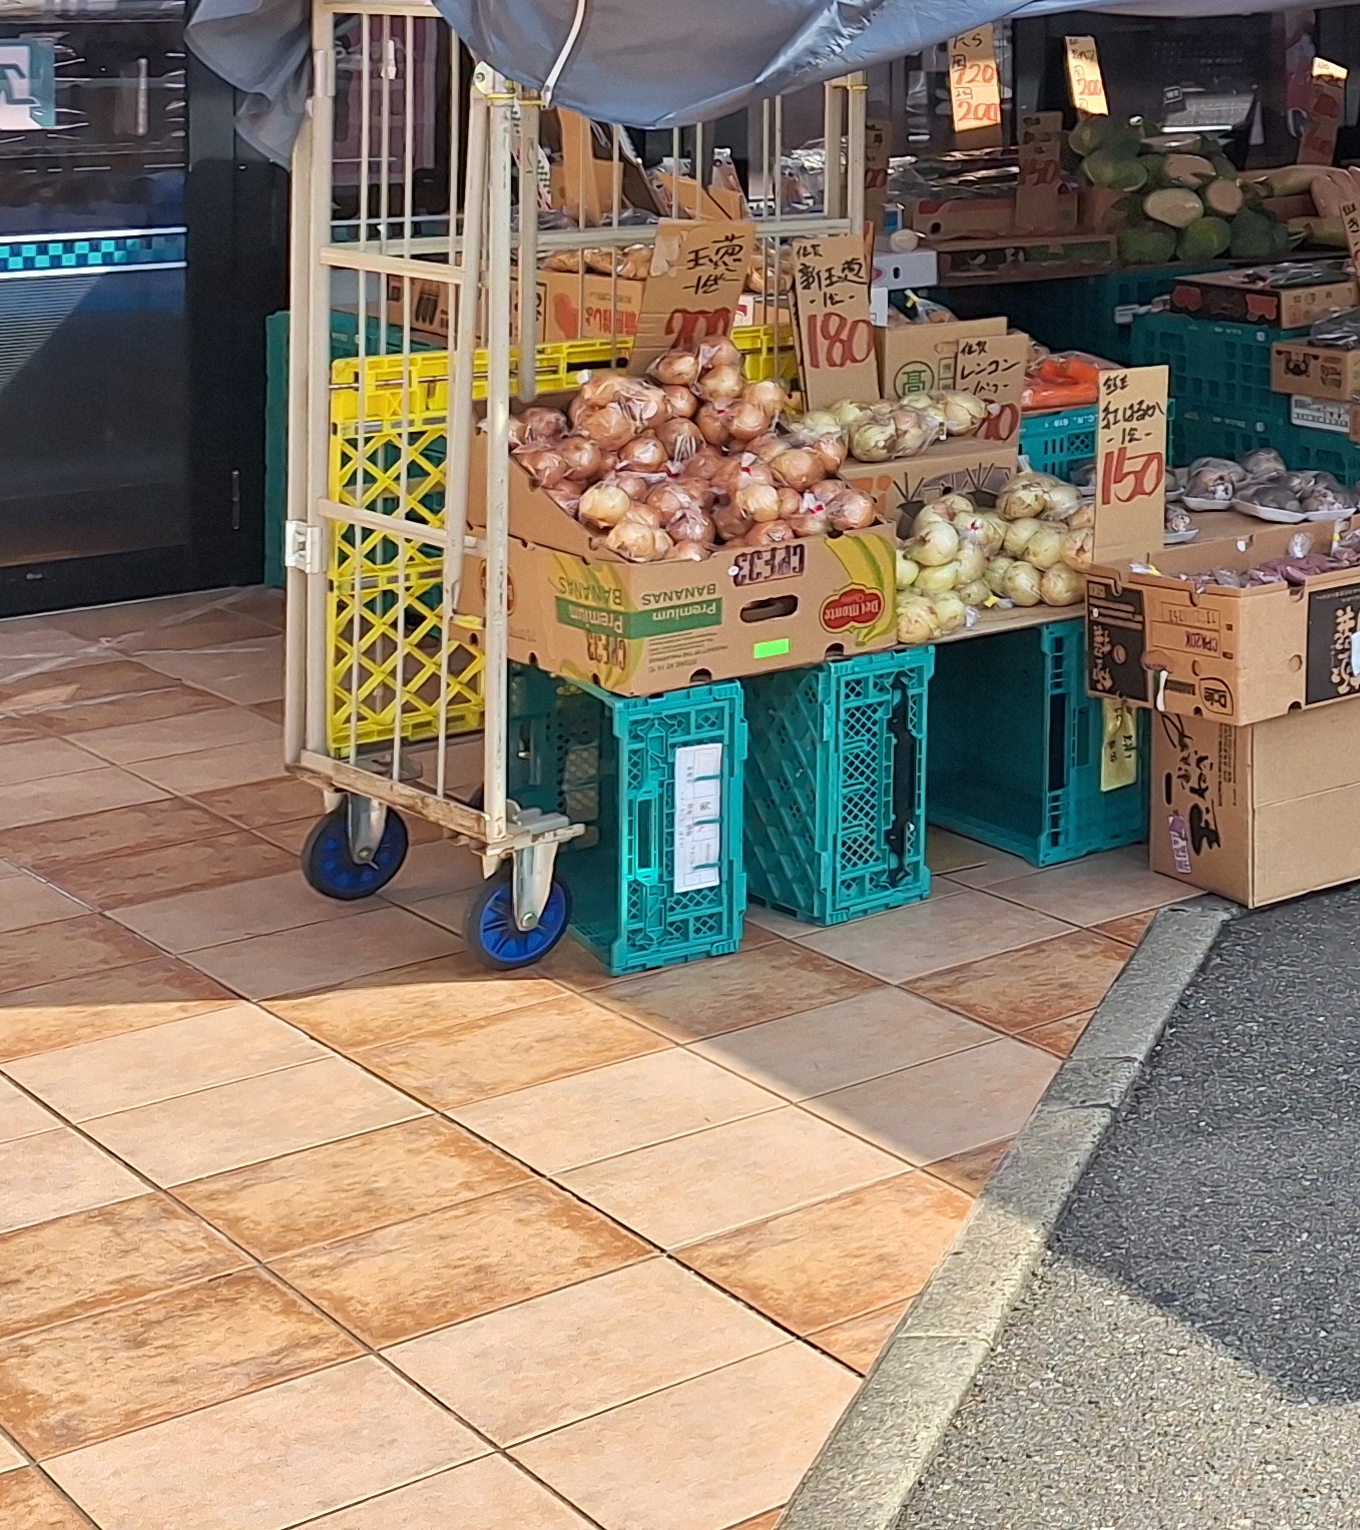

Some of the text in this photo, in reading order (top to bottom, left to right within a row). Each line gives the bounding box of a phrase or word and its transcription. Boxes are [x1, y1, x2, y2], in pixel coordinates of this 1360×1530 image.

[807, 311, 876, 369] 180
[961, 359, 1020, 380] レンコン
[1101, 446, 1165, 506] 150
[558, 576, 622, 606] BANANAS
[642, 583, 717, 605] BANANAS
[569, 604, 624, 635] Premium
[652, 601, 717, 621] Premium
[823, 596, 880, 621] Del Monte
[1203, 687, 1228, 708] Dole
